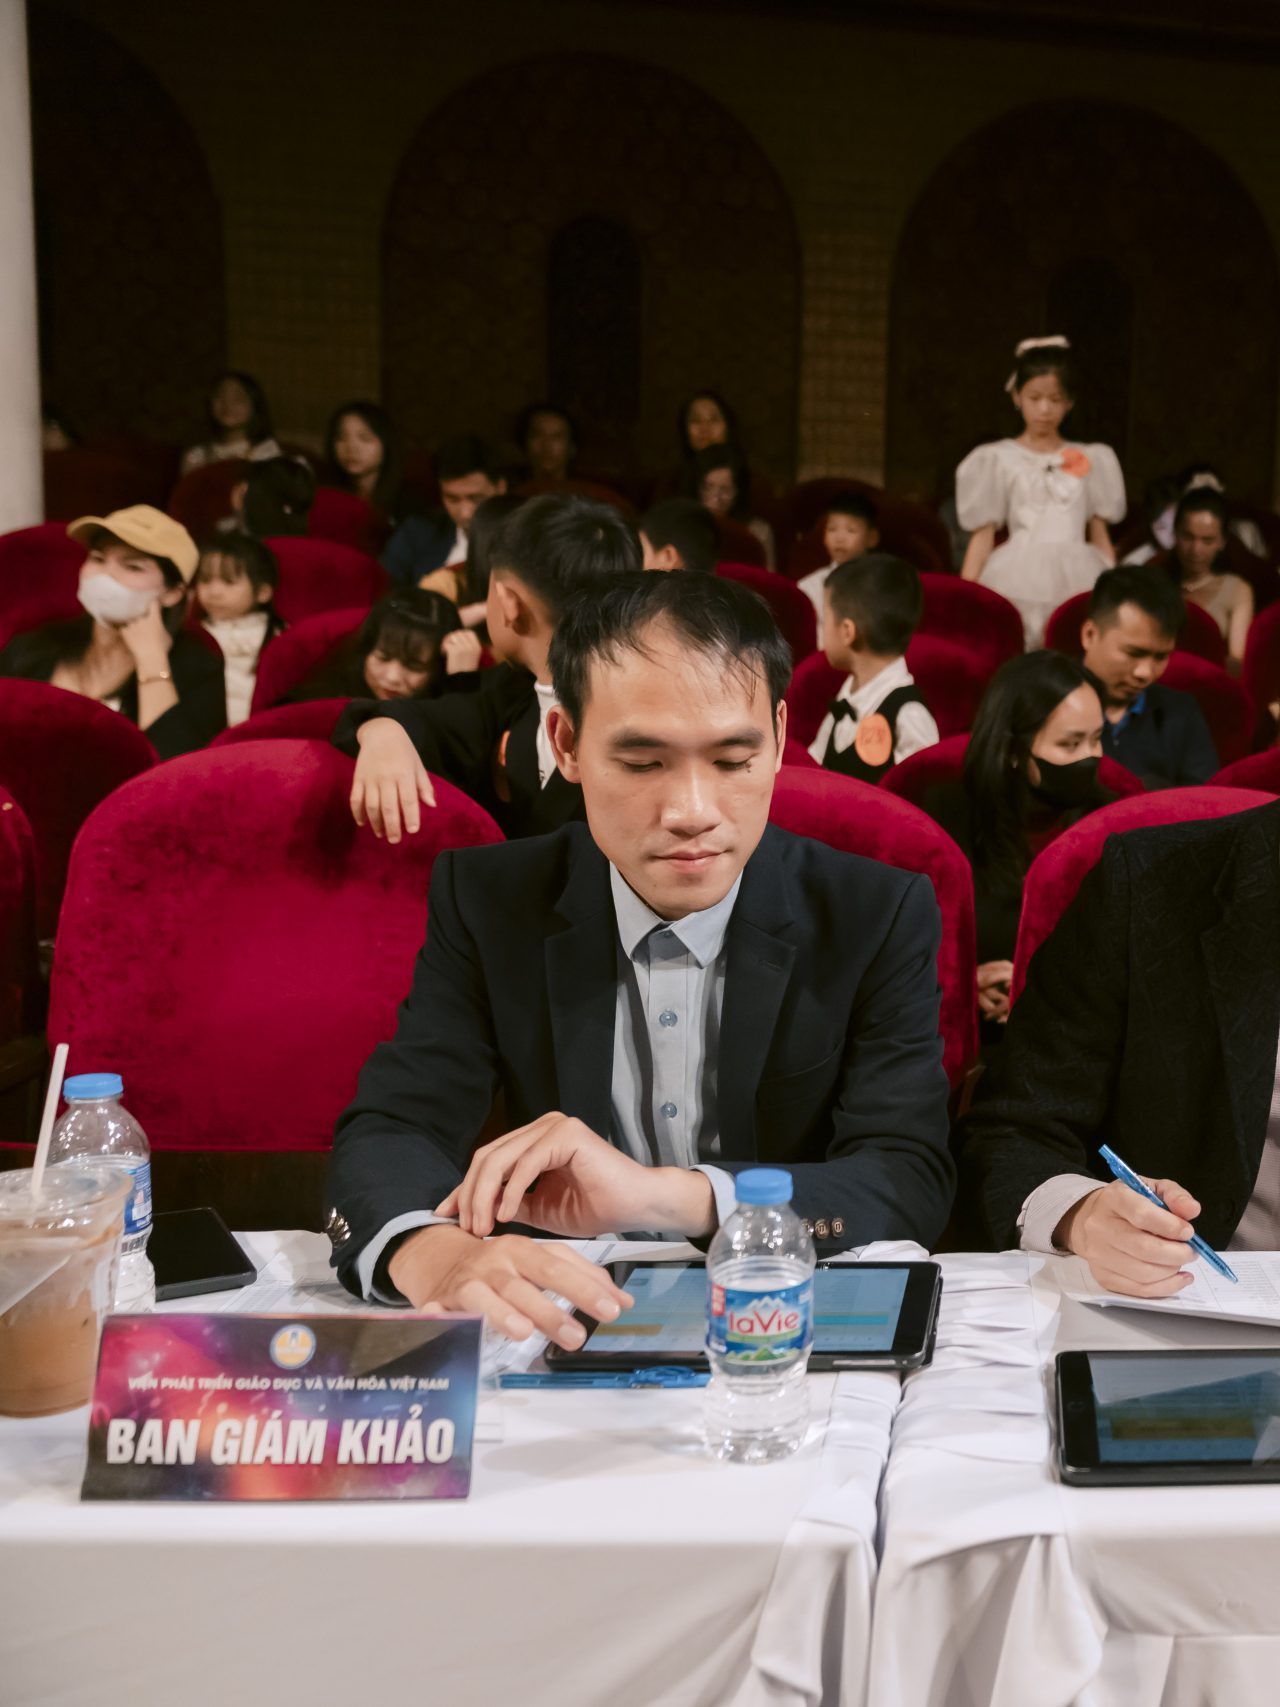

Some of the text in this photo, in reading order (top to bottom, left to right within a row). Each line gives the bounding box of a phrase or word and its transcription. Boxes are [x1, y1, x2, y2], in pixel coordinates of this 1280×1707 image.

[728, 1309, 799, 1334] laVie
[128, 1371, 158, 1391] VIỆN
[161, 1375, 195, 1391] PHÁT
[235, 1375, 271, 1390] GIÁO
[273, 1377, 301, 1392] DỤC
[304, 1375, 323, 1390] VÀ
[327, 1375, 355, 1390] VĂN
[357, 1375, 387, 1390] HÓA
[389, 1375, 417, 1392] VIỆT
[418, 1377, 449, 1390] NAM
[106, 1403, 456, 1465] BAN GIÁM KHẢO
